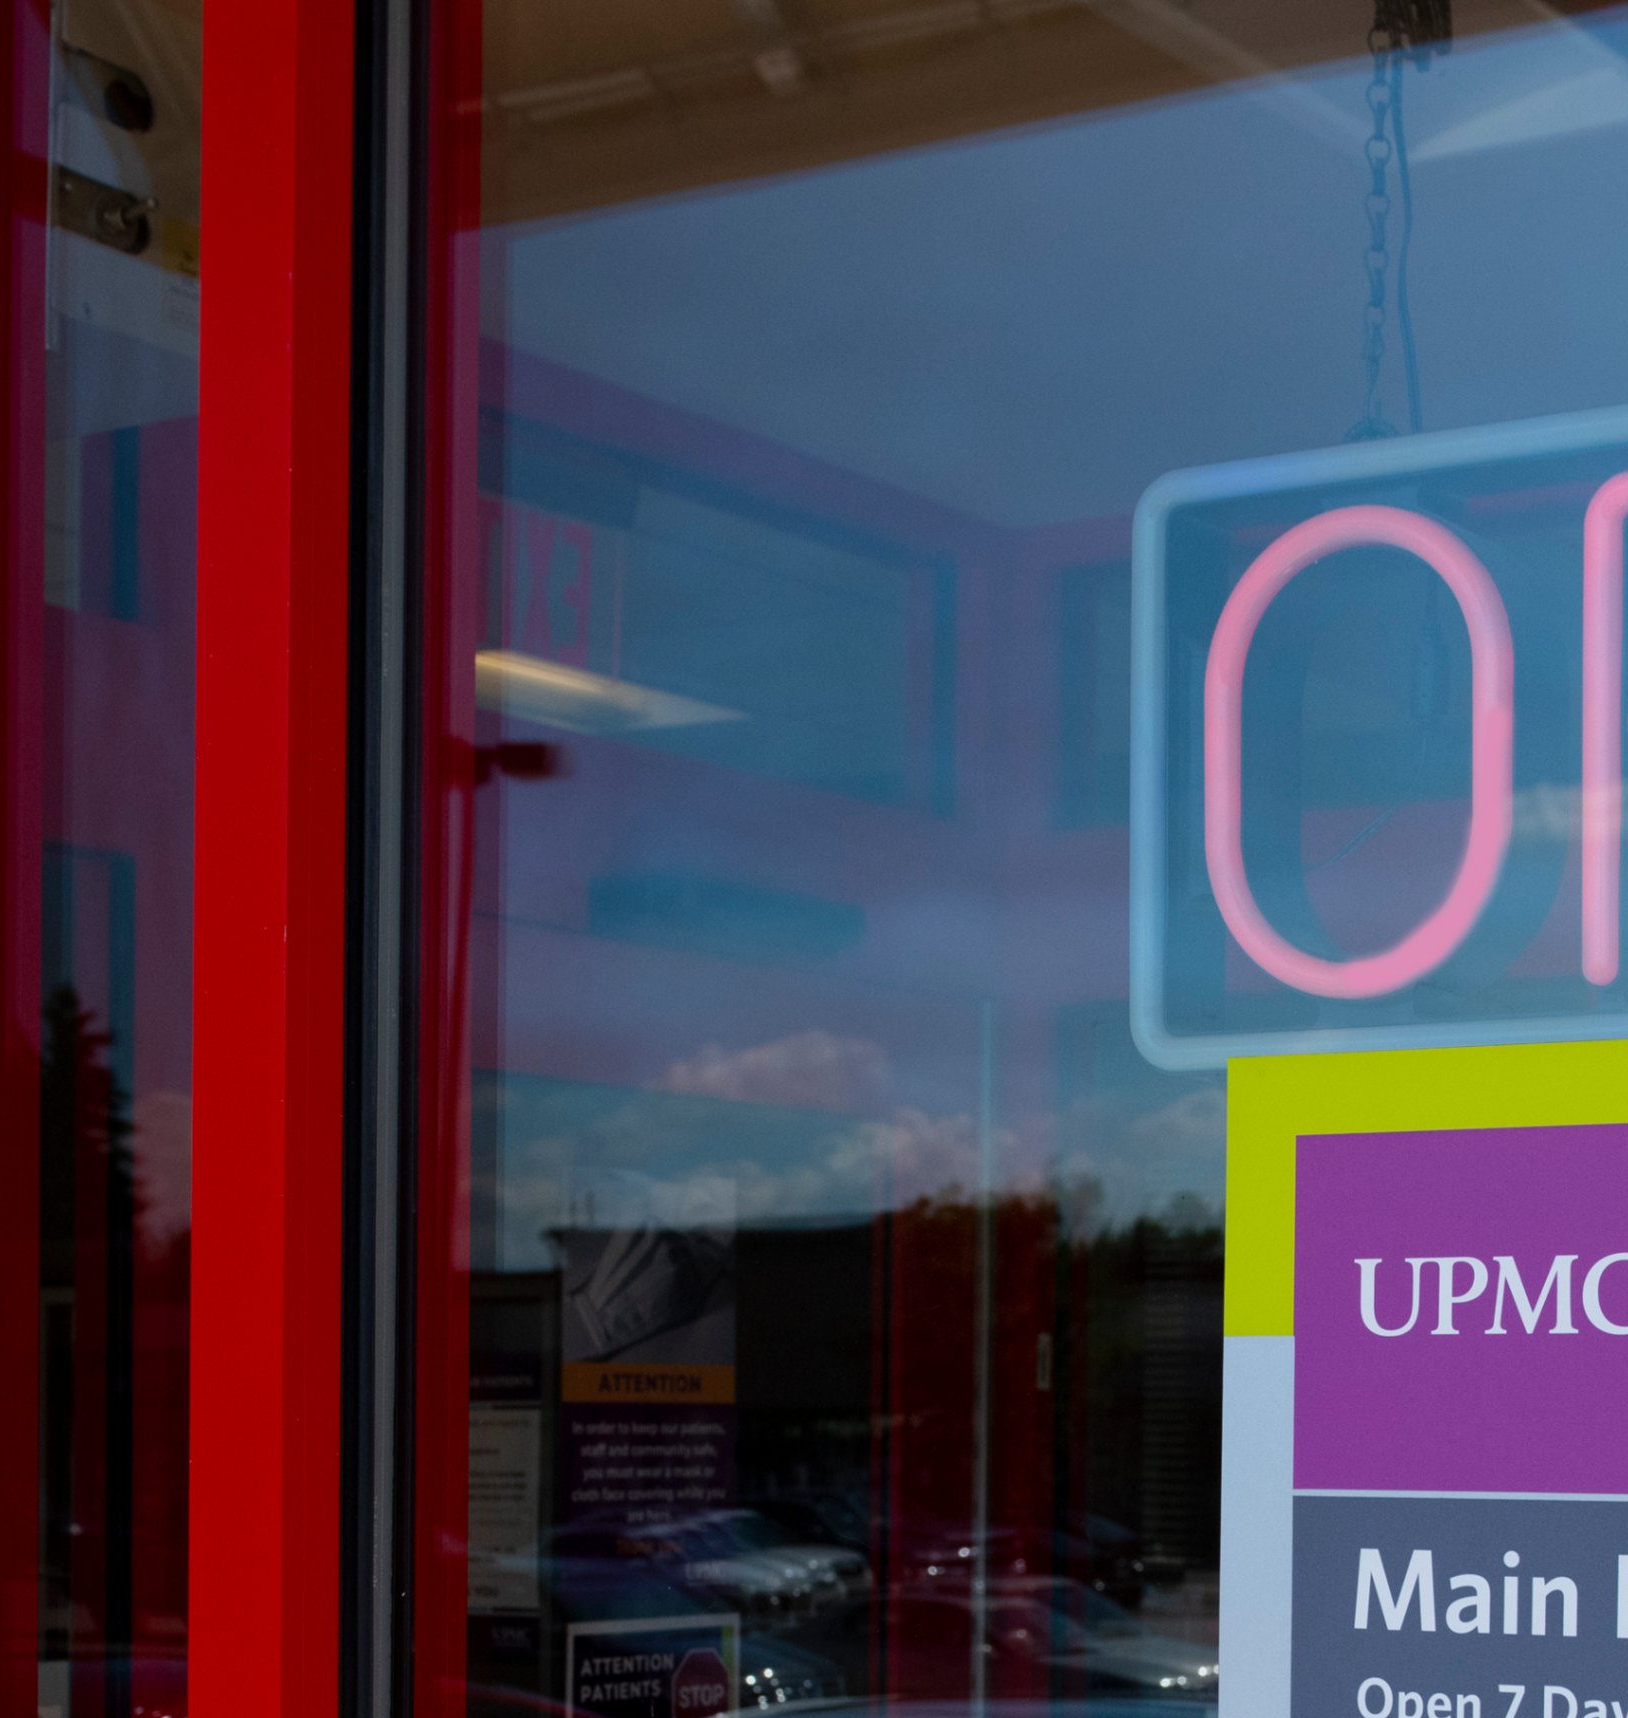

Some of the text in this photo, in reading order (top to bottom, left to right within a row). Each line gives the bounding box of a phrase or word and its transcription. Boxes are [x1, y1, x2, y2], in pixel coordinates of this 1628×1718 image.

[1354, 1548, 1577, 1637] Main
[579, 1653, 674, 1677] ATTENTION
[579, 1680, 662, 1702] PATIENTS
[679, 1684, 725, 1709] STOP
